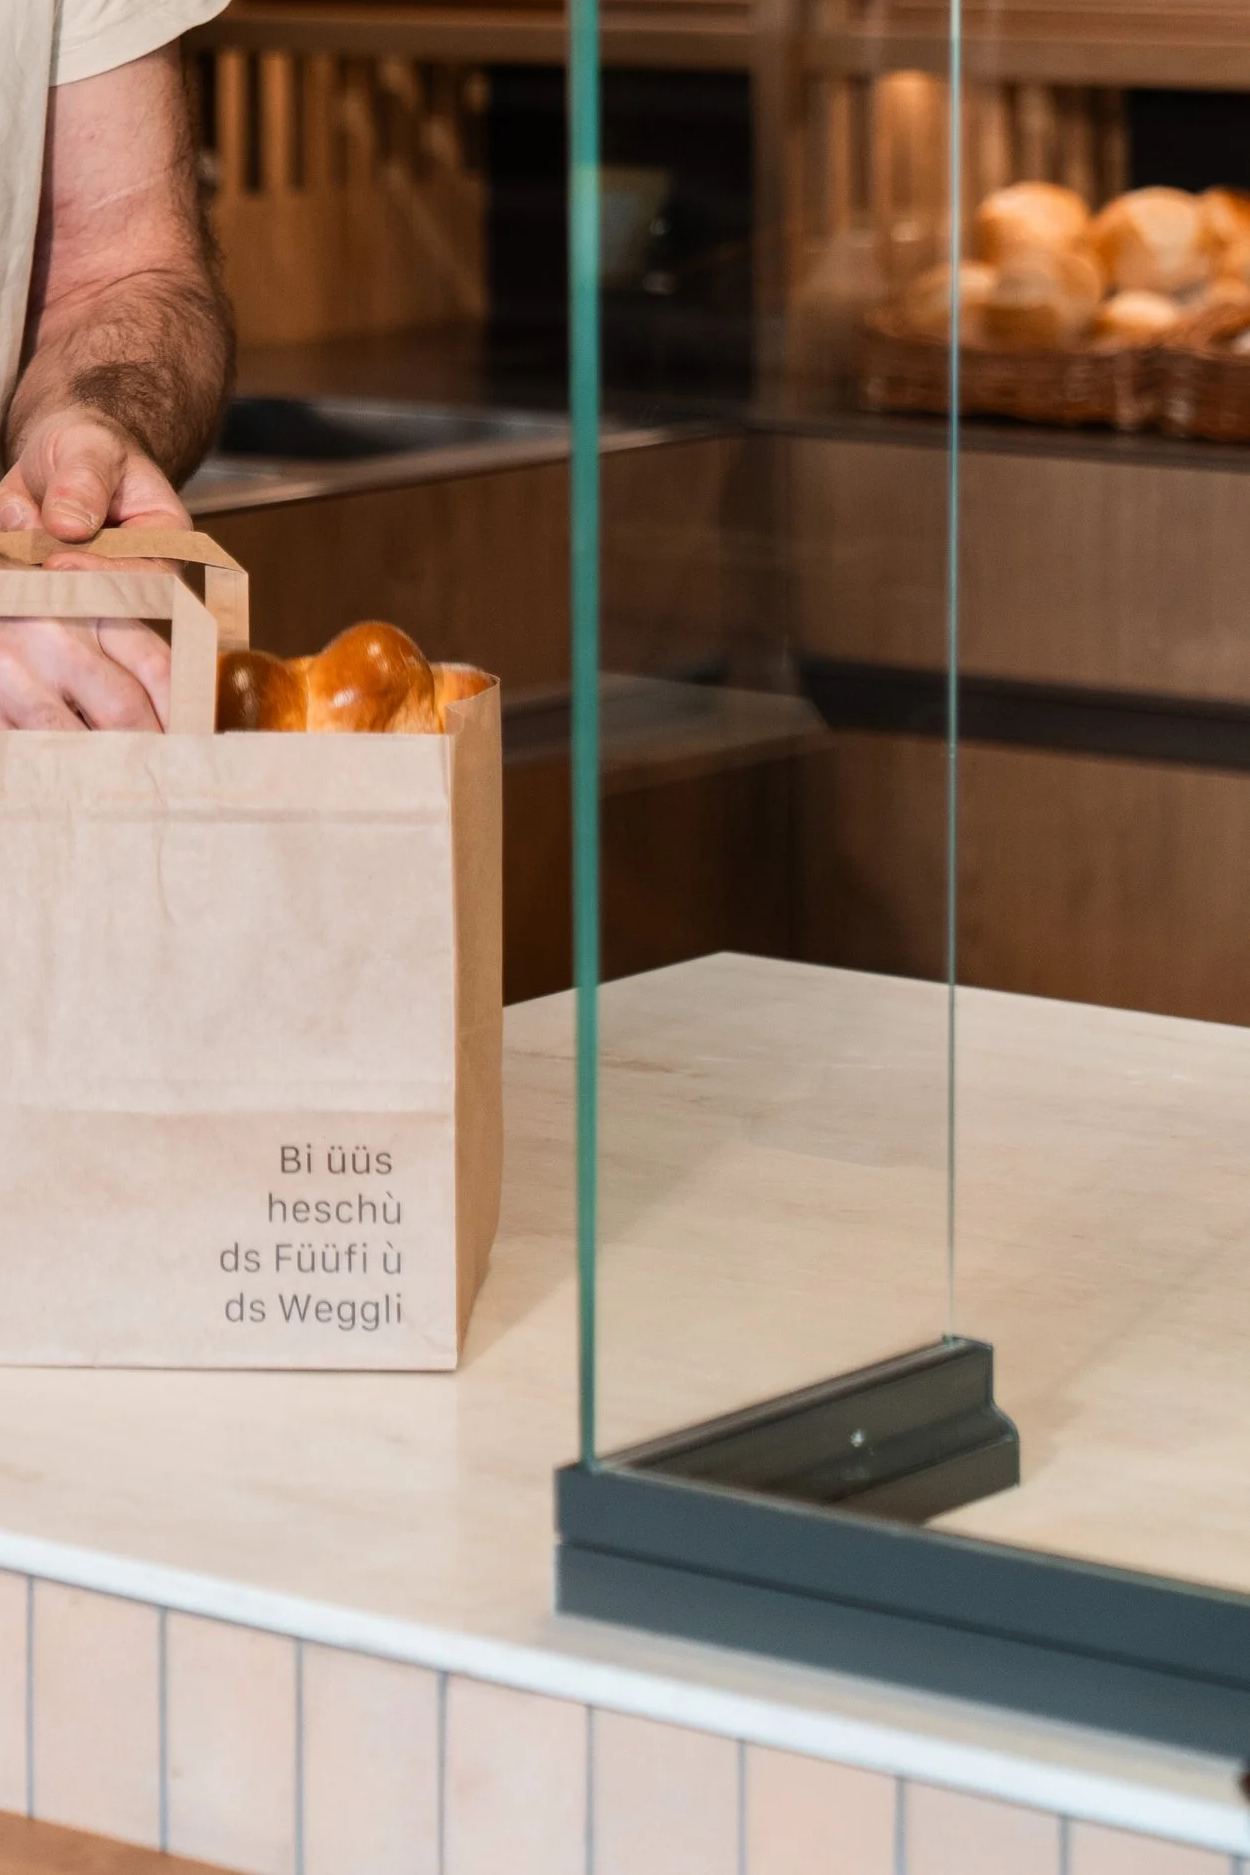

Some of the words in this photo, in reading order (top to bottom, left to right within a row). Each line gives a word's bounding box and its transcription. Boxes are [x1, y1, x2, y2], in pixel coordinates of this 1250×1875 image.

[280, 1143, 312, 1174] Bi
[327, 1145, 393, 1175] üüs
[267, 1191, 402, 1224] heschù
[219, 1242, 261, 1273] ds
[275, 1242, 368, 1273] Füüfi
[382, 1241, 402, 1274] ù
[225, 1292, 266, 1323] ds
[278, 1293, 402, 1332] Weggli
